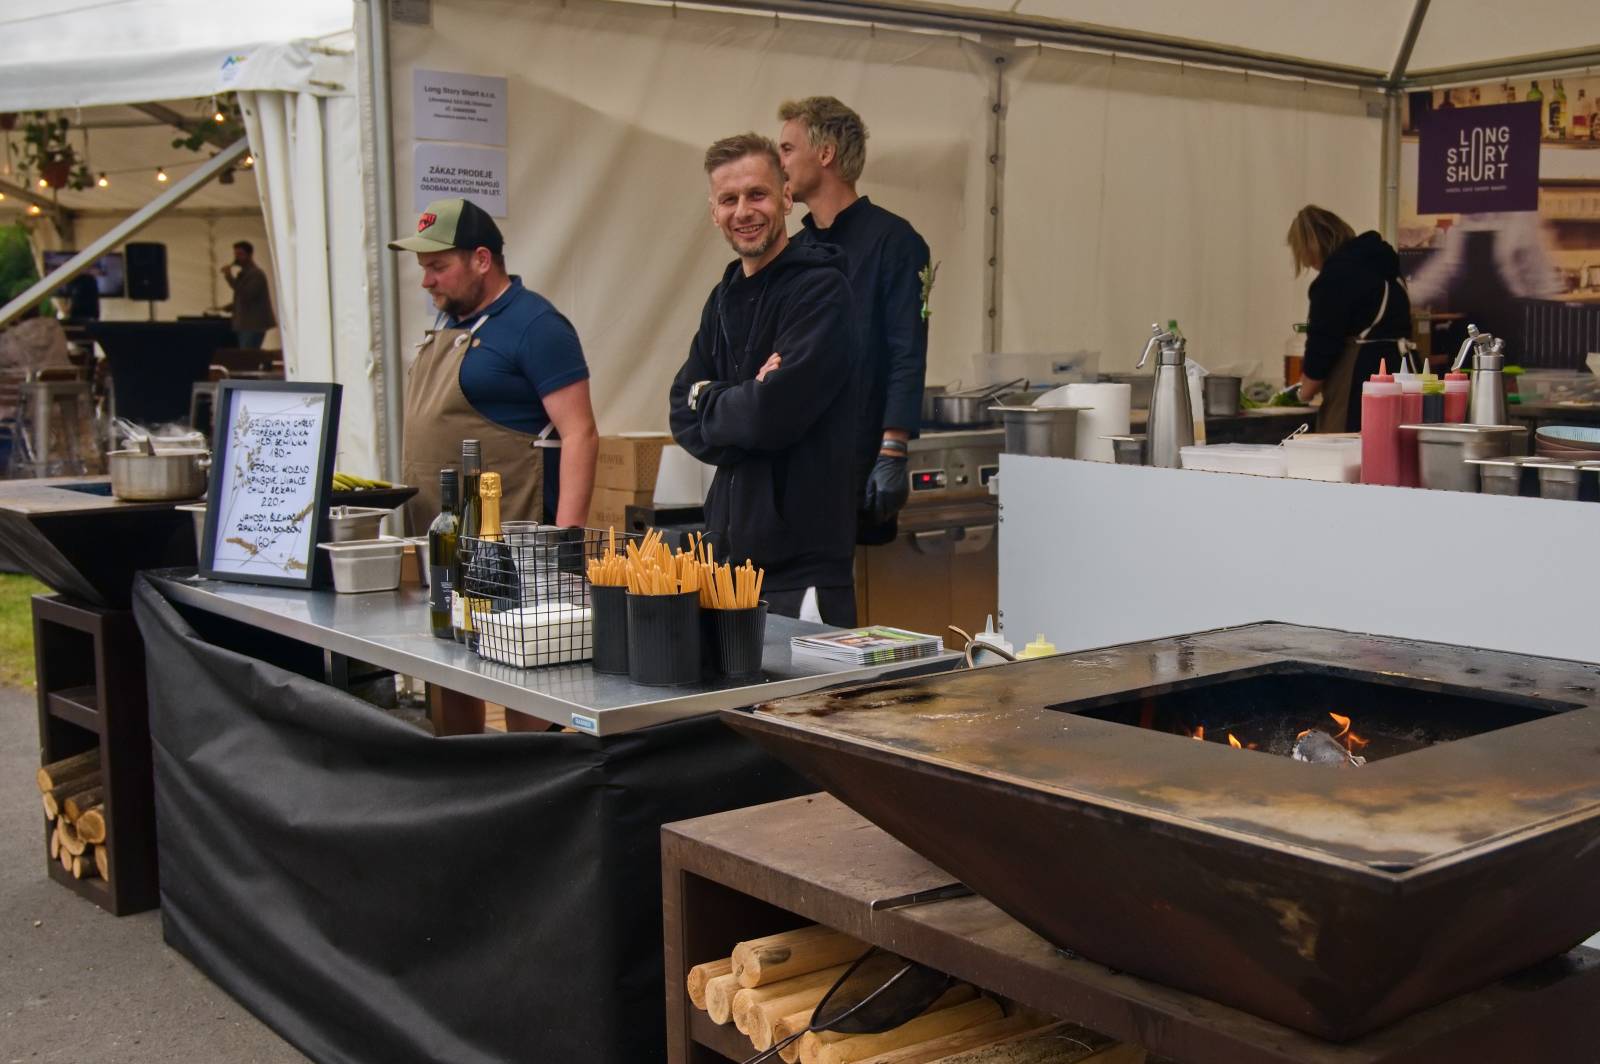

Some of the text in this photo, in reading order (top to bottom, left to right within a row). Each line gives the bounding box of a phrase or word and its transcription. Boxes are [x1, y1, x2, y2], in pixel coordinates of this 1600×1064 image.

[424, 85, 441, 95] Long
[443, 87, 460, 96] Story
[462, 89, 479, 97] Short
[1460, 126, 1510, 146] LONG
[1447, 145, 1509, 164] STORY
[429, 165, 493, 178] ZÁKAZ PRODEJE
